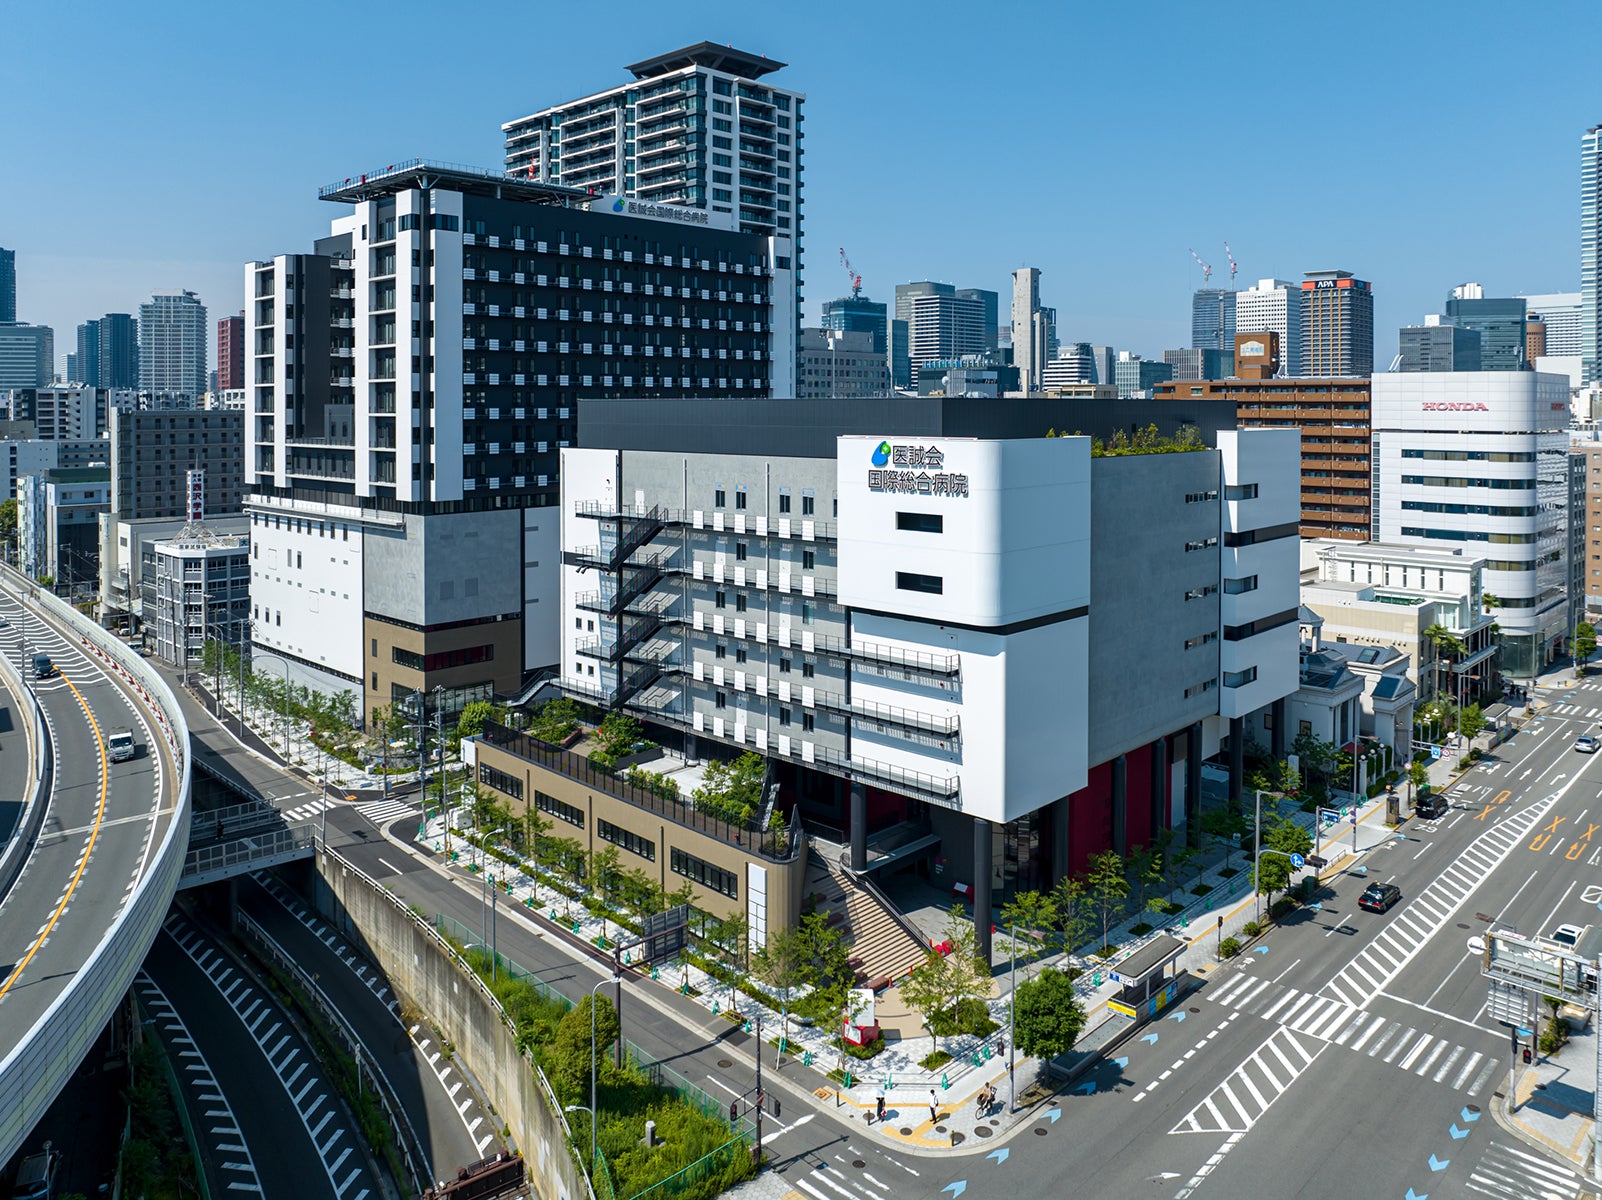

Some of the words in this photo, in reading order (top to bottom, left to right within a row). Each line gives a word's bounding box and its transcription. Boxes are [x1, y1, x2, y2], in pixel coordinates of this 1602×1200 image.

[1317, 280, 1334, 288] APA
[1422, 402, 1489, 411] HONDA
[892, 445, 943, 467] 医誠会
[868, 469, 968, 496] 国際総合病院
